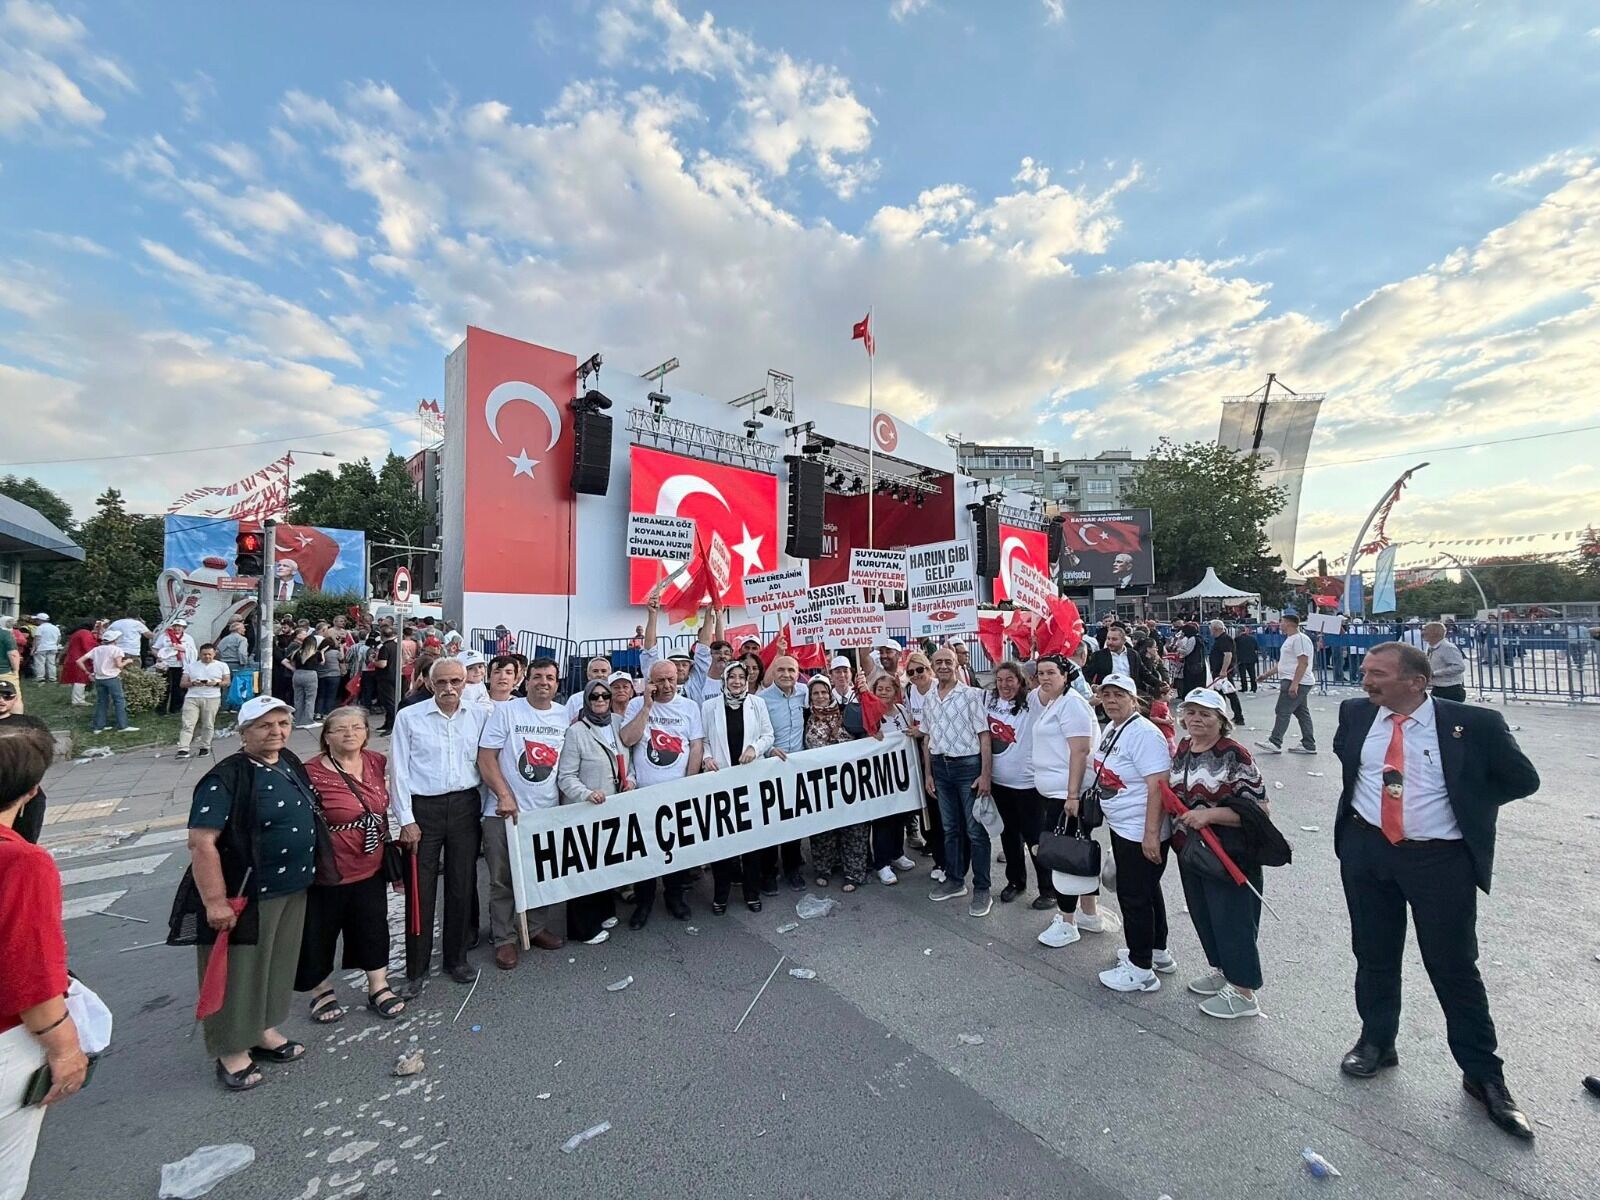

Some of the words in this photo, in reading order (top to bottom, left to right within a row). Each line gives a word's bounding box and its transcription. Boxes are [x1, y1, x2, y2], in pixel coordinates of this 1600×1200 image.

[632, 516, 675, 527] MERAMIZA
[676, 520, 692, 528] GÖZ
[634, 527, 677, 537] KOYANLAR
[678, 530, 689, 539] İKİ
[629, 535, 665, 546] CİHANDA
[666, 541, 692, 549] HUZUR
[630, 547, 690, 560] BULMASIN!
[855, 550, 906, 560] SUYUMUZU
[909, 549, 946, 569] HARUN
[948, 544, 969, 564] GİBİ
[856, 560, 902, 571] KURUTAN,
[744, 575, 766, 585] TEMİZ
[766, 569, 802, 581] ENERJİNİN
[851, 569, 905, 580] MUAVİYELERE
[925, 564, 955, 581] GELİP
[851, 578, 877, 587] LANET
[878, 580, 904, 588] OLSUN
[911, 579, 973, 598] KARUNLAŞANLARA
[1013, 573, 1047, 600] TOPRAĞ
[746, 592, 774, 605] TEMİZ
[775, 588, 806, 599] TALAN
[807, 584, 845, 600] AŞASIN
[911, 598, 975, 613] #BayrakAçıyorum
[1016, 590, 1041, 609] SAHİP
[761, 600, 795, 612] OLMUŞ
[830, 606, 861, 615] FAKİRDEN
[862, 606, 876, 614] ALIP
[1041, 605, 1050, 617] ÇI
[791, 613, 822, 625] YAŞASI
[824, 616, 852, 625] ZENGİNE
[852, 615, 884, 623] VERMENİN
[796, 626, 824, 636] #Bayra
[828, 628, 845, 636] ADI
[847, 626, 882, 635] ADALET
[532, 813, 648, 883] HAVZA
[655, 785, 752, 864] ÇEVRE
[759, 749, 910, 827] PLATFORMU
